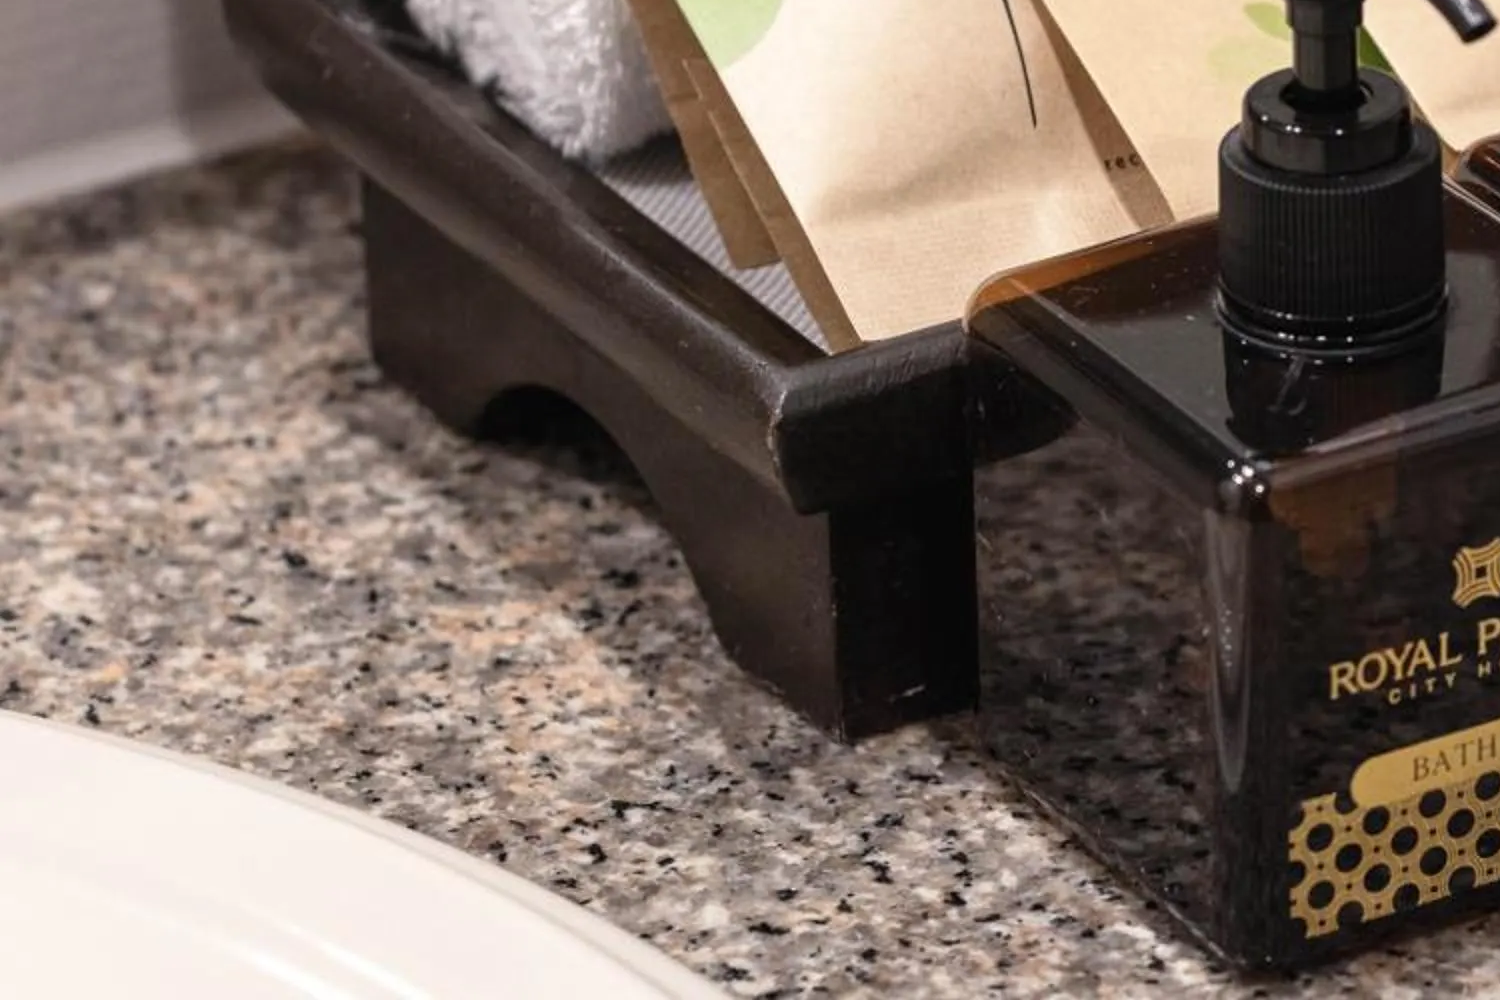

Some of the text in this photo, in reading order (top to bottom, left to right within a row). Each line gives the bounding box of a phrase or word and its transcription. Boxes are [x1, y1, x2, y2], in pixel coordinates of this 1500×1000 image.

[1104, 153, 1142, 171] rec
[1328, 630, 1463, 701] ROYAL
[1387, 672, 1459, 706] CITY
[1411, 734, 1498, 782] BATH
